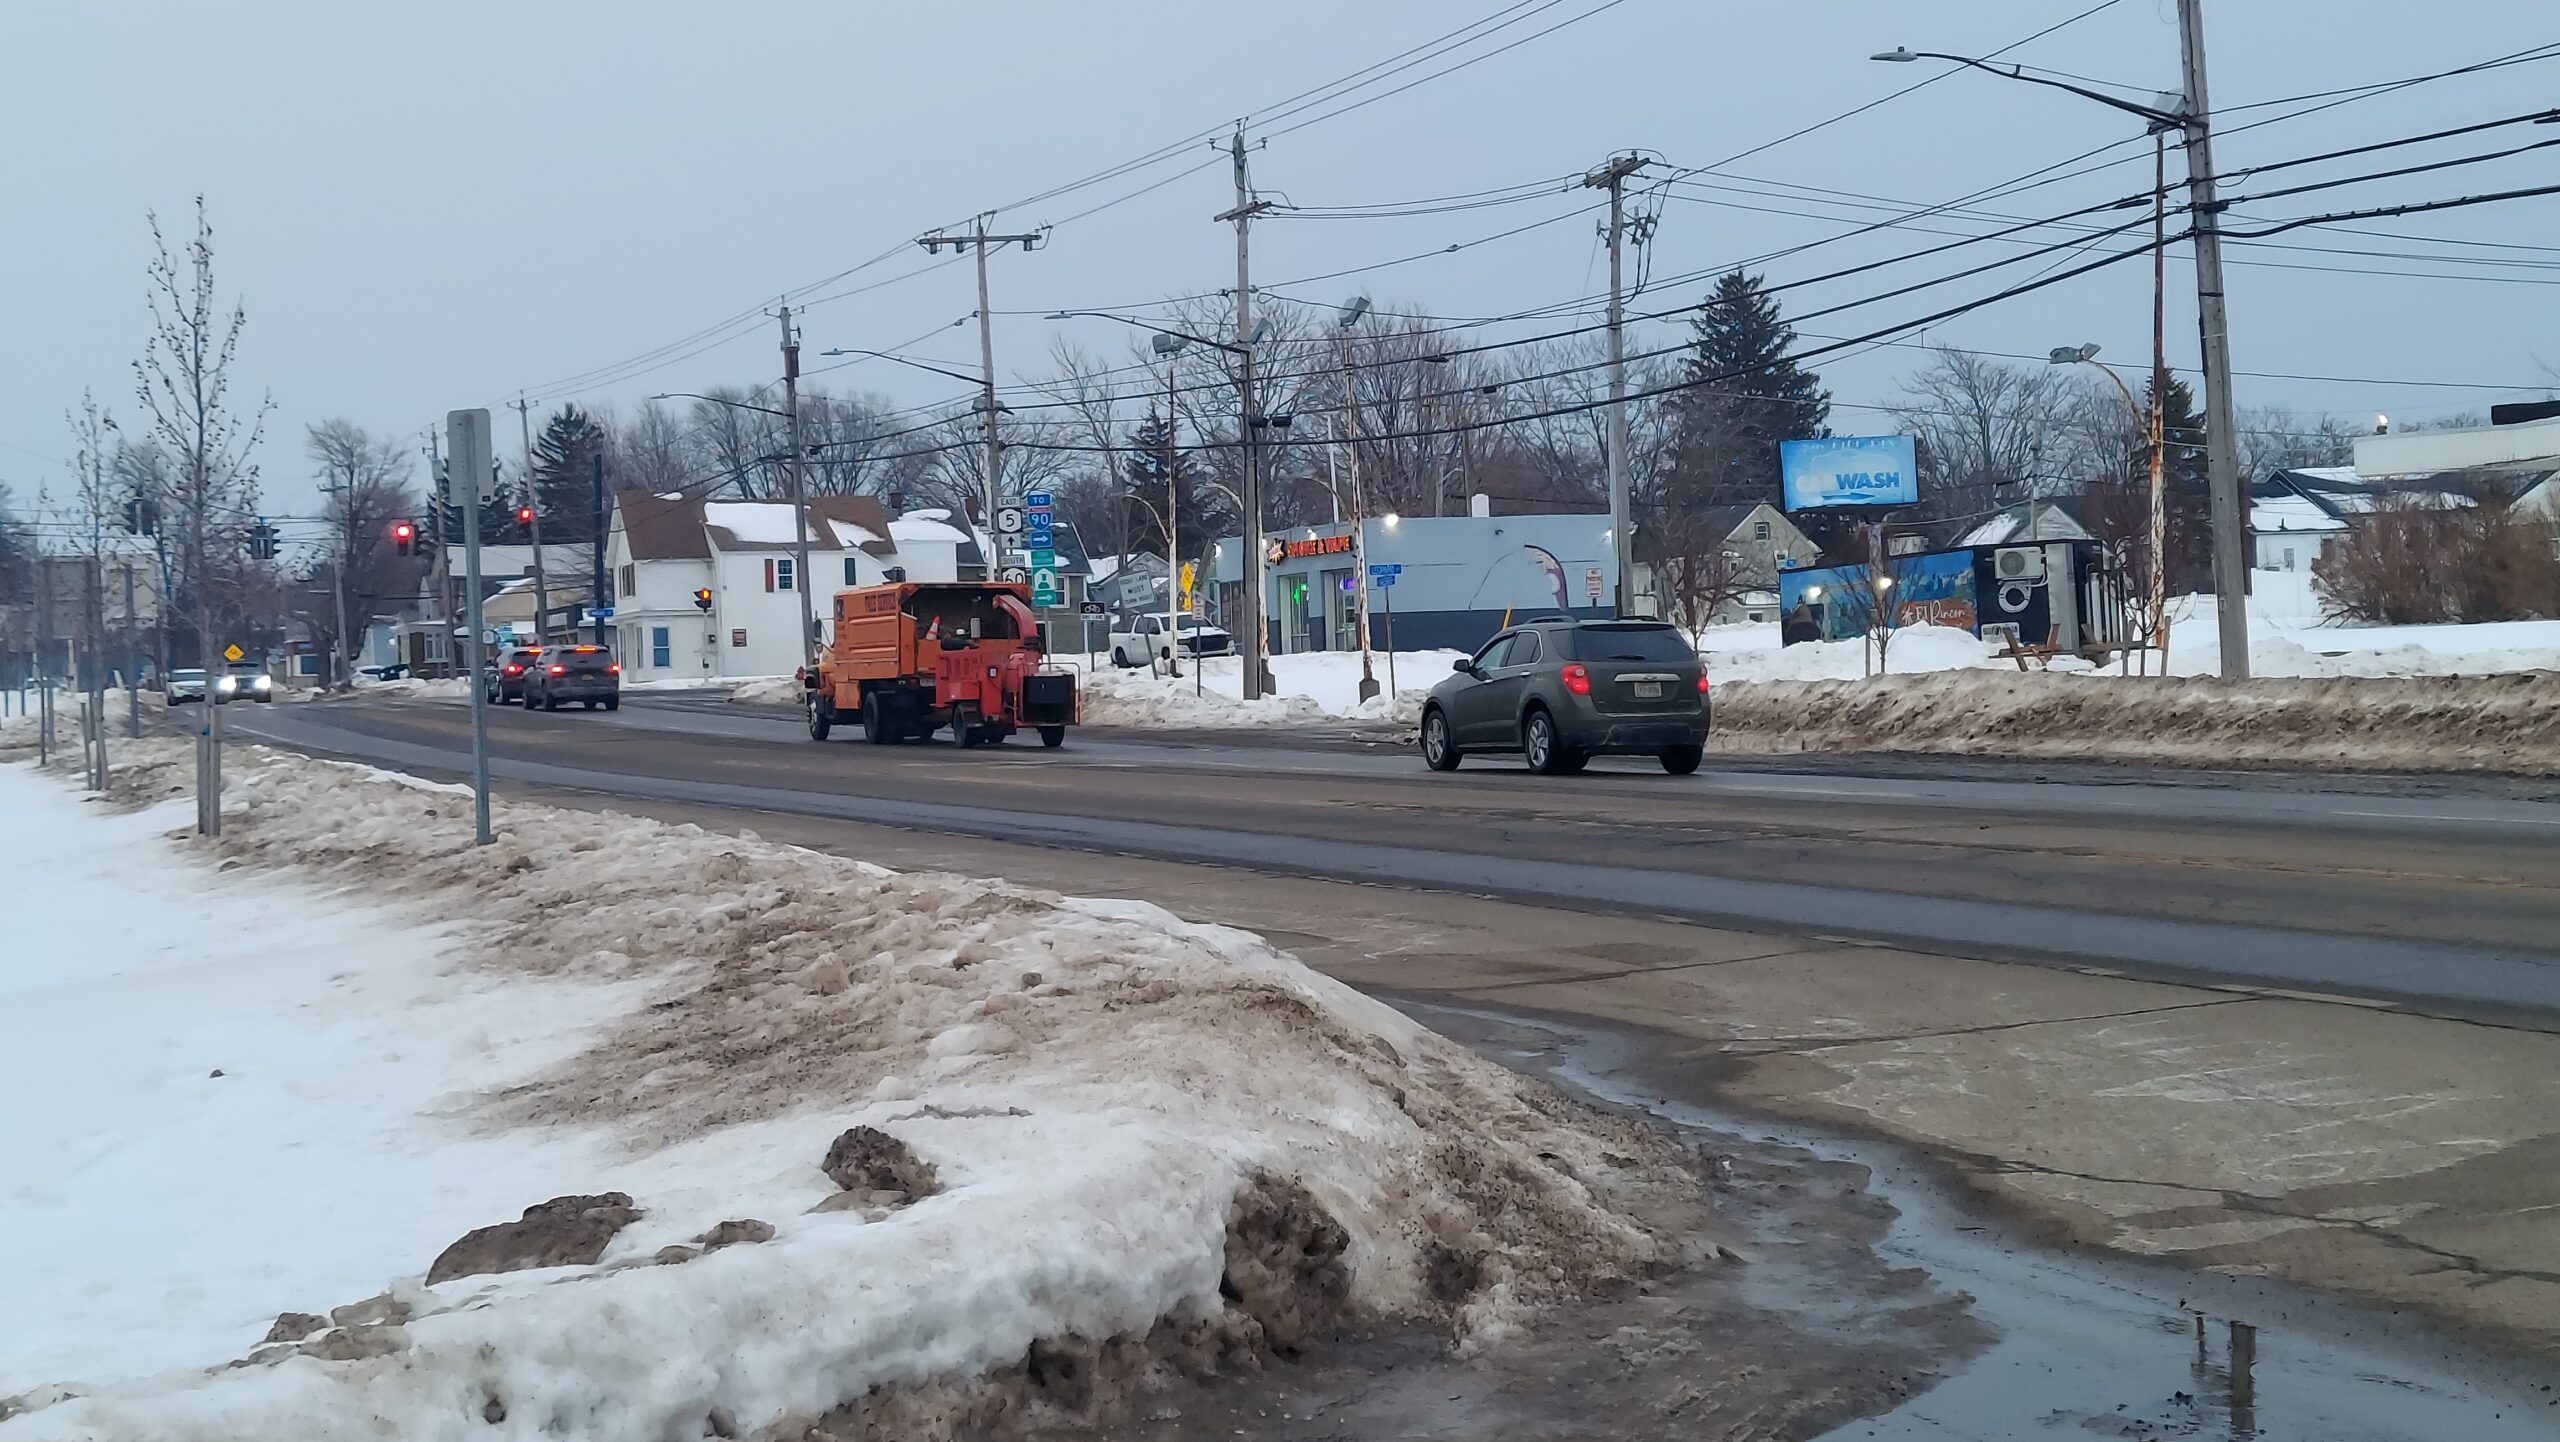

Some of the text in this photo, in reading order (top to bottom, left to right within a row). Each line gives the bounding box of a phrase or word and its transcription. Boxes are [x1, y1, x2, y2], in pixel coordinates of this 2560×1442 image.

[1836, 472, 1900, 490] WASH
[1001, 498, 1017, 506] EAST
[1032, 497, 1045, 505] TO
[1006, 514, 1015, 527] 5
[1031, 514, 1049, 525] 90
[1003, 557, 1023, 566] SOUTH
